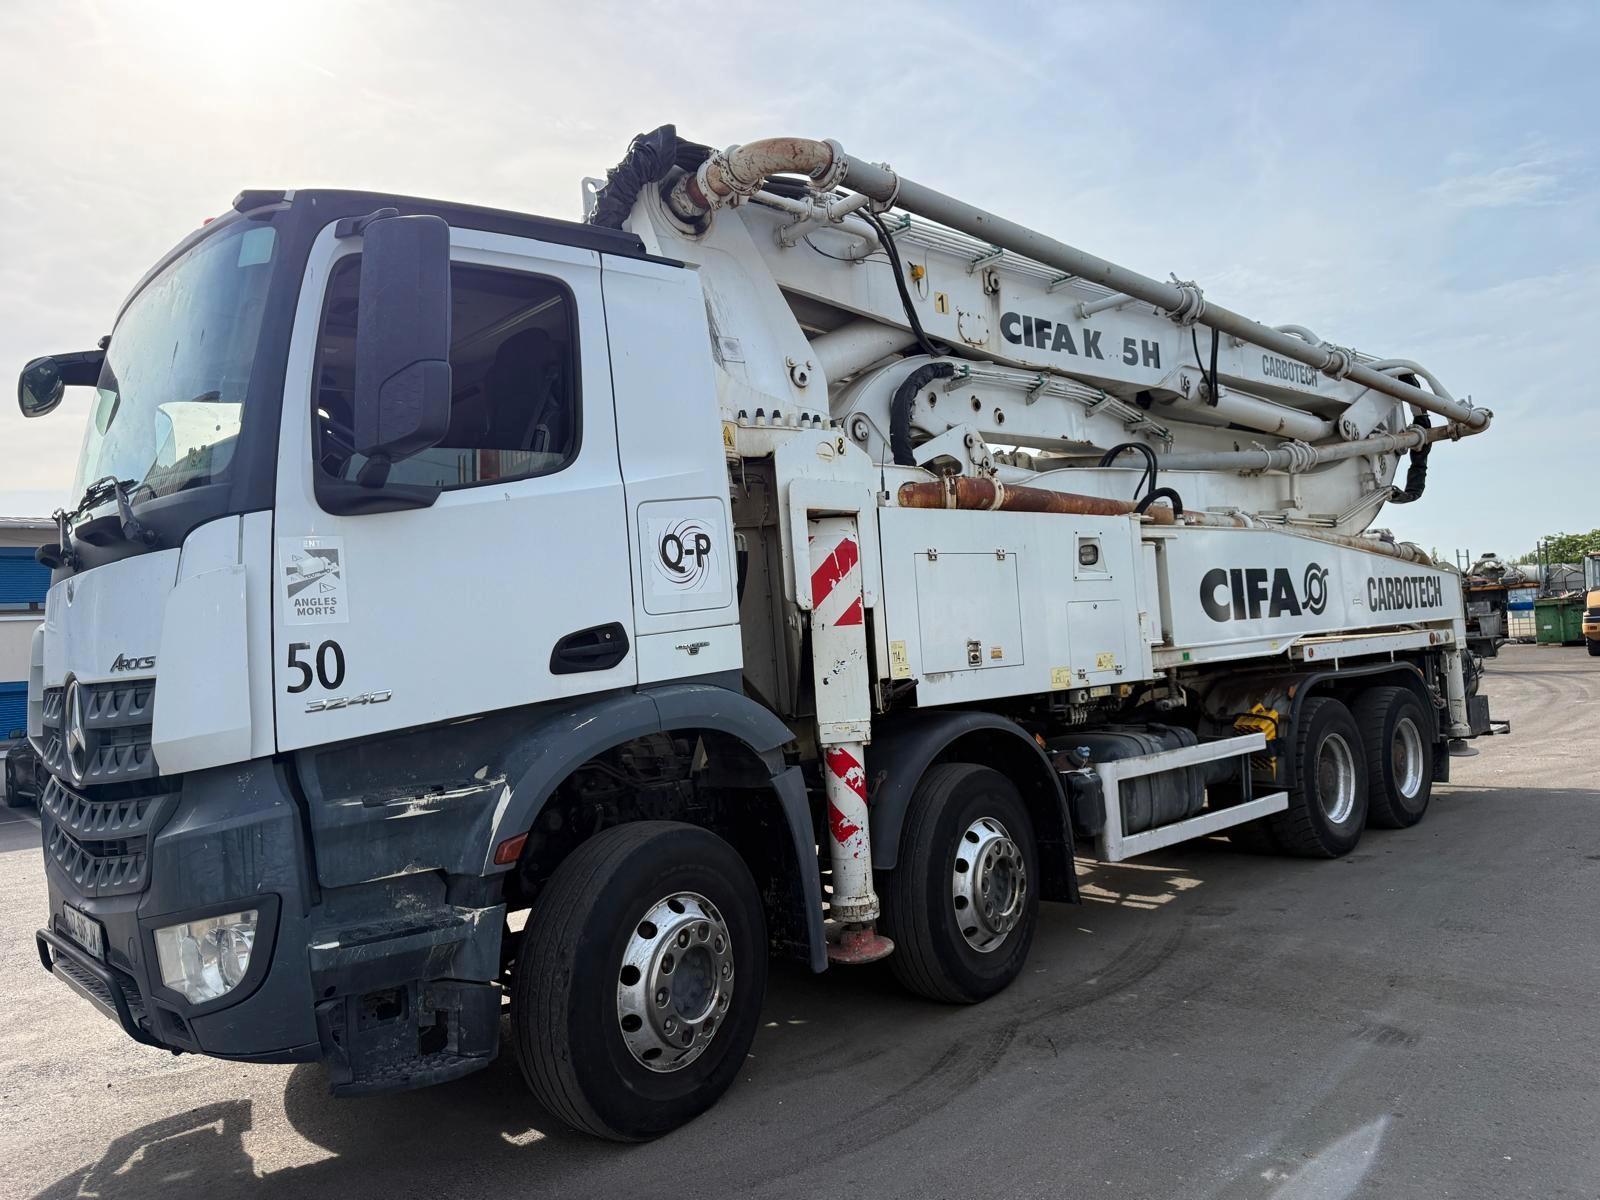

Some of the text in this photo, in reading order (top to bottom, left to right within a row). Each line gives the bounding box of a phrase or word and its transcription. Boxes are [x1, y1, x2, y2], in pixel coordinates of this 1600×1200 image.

[938, 294, 945, 312] 1
[1000, 311, 1161, 369] CIFA K 5H
[1262, 354, 1318, 387] CARBOTECH
[294, 597, 337, 608] ANGLES
[1199, 568, 1303, 622] CIFA
[1367, 576, 1443, 612] CARBOTECH
[297, 606, 336, 616] MORTS
[286, 639, 346, 693] 50
[305, 689, 392, 713] 3240
